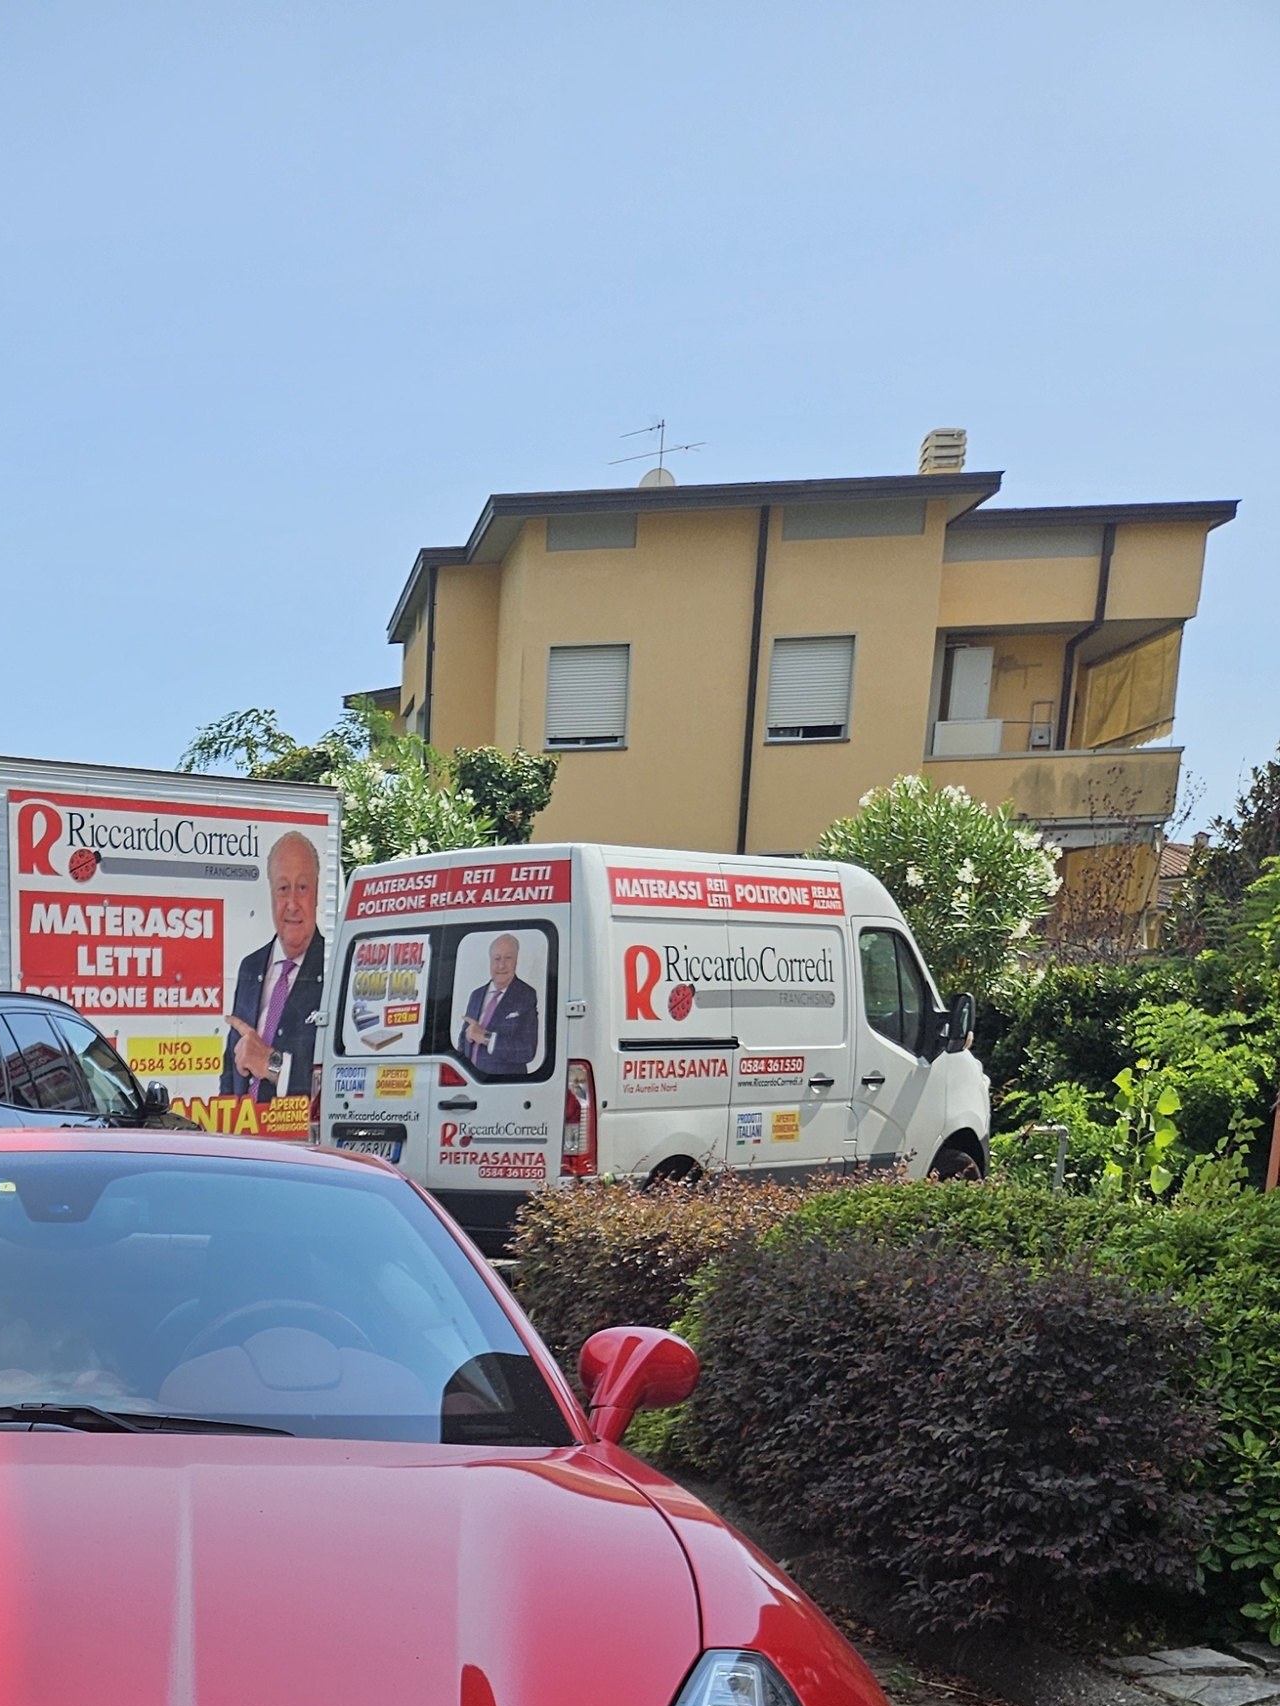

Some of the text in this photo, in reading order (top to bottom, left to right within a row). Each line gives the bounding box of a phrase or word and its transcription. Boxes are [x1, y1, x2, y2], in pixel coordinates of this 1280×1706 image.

[66, 812, 260, 858] RiccardoCorredi
[204, 865, 258, 879] FRANCHISING
[363, 866, 552, 897] MATERASSI RETI LETTI
[706, 878, 728, 892] RETI
[615, 878, 702, 901] MATERASSI
[734, 884, 810, 906] POLTRONE
[811, 886, 841, 900] RELAX
[357, 886, 554, 916] POLTRONE RELAX ALZANTI
[707, 893, 732, 908] LETTI
[813, 899, 842, 910] ALZANTI
[30, 903, 214, 939] MATERASSI
[77, 946, 163, 977] LETTI
[356, 942, 391, 966] SALDI
[662, 945, 835, 983] RiccardoCorredi
[354, 971, 388, 996] COME
[153, 986, 220, 1009] RELAX
[778, 992, 835, 1006] FRANCHISING
[158, 1043, 192, 1056] INFO
[129, 1057, 221, 1072] 0584 361550
[622, 1058, 729, 1080] PIETRASANTA
[740, 1059, 803, 1074] 0584 361550
[336, 1067, 367, 1078] PRODOTTI
[381, 1069, 409, 1078] APERTO
[334, 1080, 366, 1092] ITALIANI
[376, 1080, 412, 1089] DOMENICA
[622, 1082, 678, 1093] Via Aurelia Nord
[737, 1077, 804, 1087] www.RiccardoCorredi.it
[269, 1095, 309, 1111] APERTO
[328, 1111, 420, 1122] www.RiccardoCorredi.it
[459, 1122, 548, 1136] RiccardoCorredi
[439, 1151, 546, 1167] PIETRASANTA
[479, 1167, 544, 1178] 0584 361550
